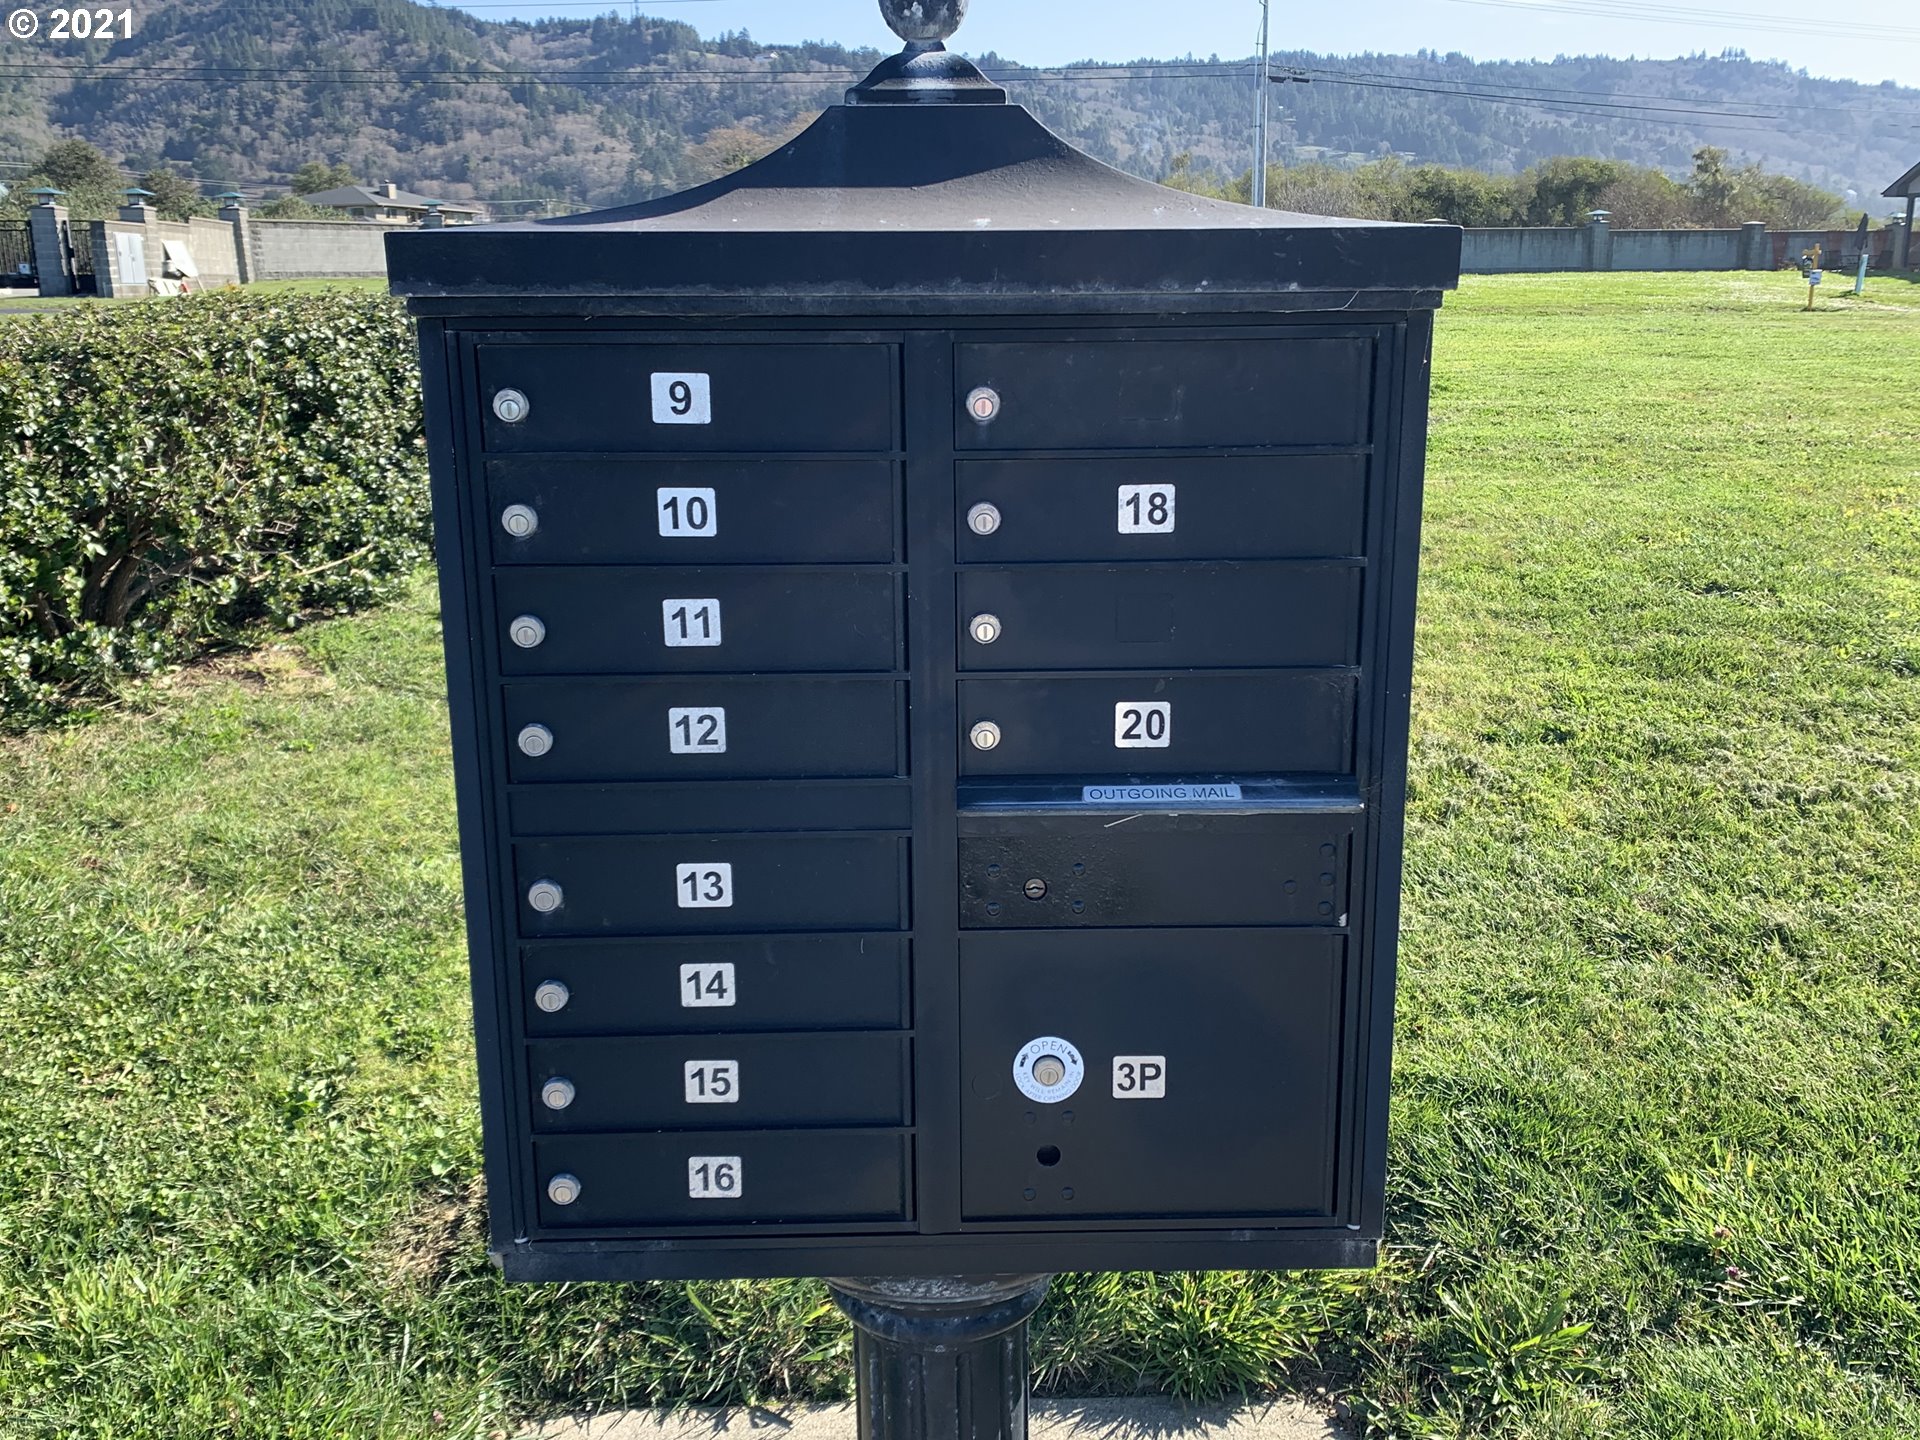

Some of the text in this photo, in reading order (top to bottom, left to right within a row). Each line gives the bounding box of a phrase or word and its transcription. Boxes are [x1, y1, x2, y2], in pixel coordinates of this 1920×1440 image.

[669, 381, 691, 415] 9
[662, 496, 708, 530] 10
[1126, 492, 1168, 525] 18
[672, 606, 711, 639] 11
[675, 715, 719, 745] 12
[1122, 710, 1163, 740] 20
[1089, 786, 1235, 800] OUTGOING MAIL
[683, 870, 723, 901] 13
[687, 971, 728, 999] 14
[1030, 1040, 1068, 1054] OPEN
[690, 1068, 730, 1096] 15
[1117, 1063, 1160, 1092] 3P
[696, 1163, 735, 1191] 16
